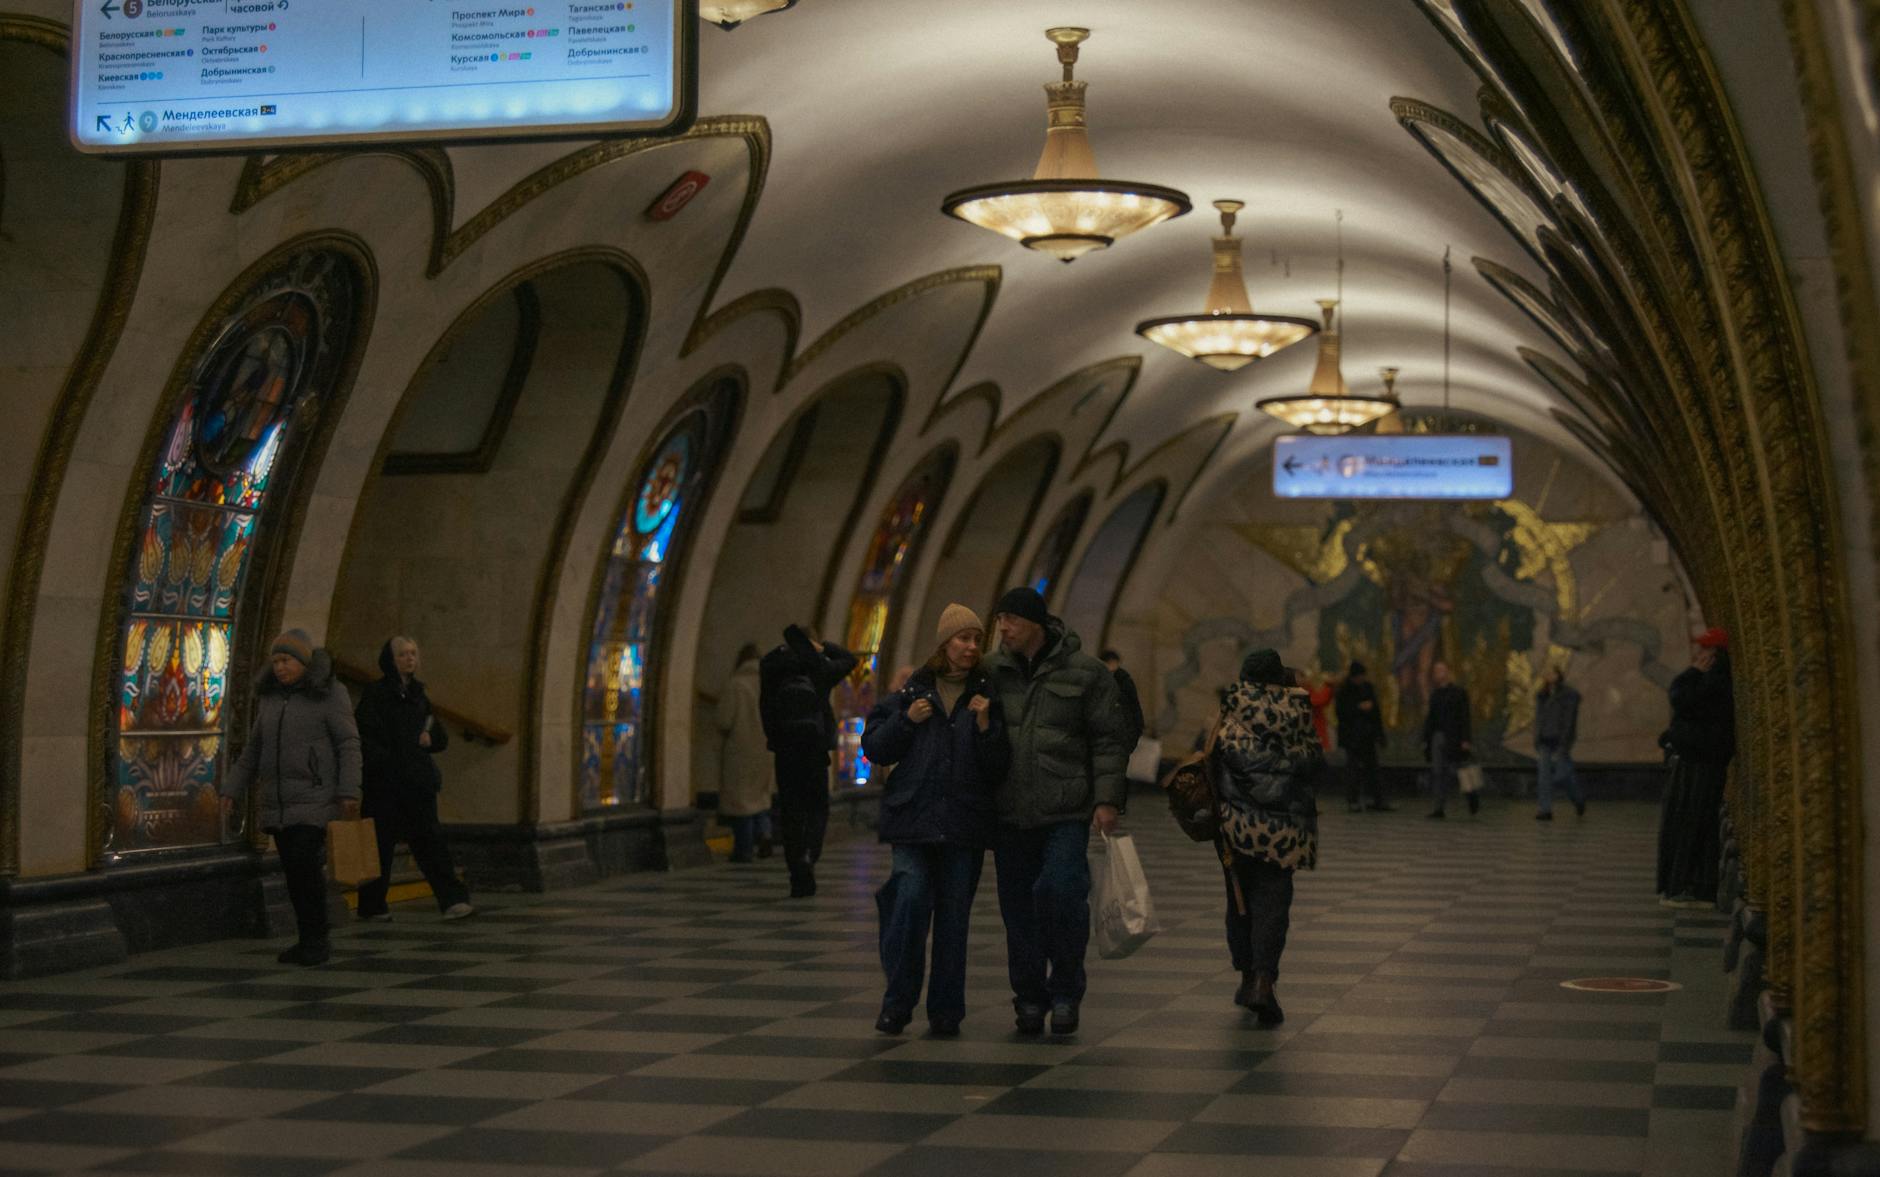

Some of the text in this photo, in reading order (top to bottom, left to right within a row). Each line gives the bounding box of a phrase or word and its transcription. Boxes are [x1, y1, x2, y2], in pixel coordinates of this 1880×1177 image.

[129, 2, 138, 15] 5
[230, 3, 274, 14] часовой
[568, 4, 615, 13] Таганская
[452, 9, 526, 21] Проспект Мира
[202, 23, 267, 36] Парк культуры
[568, 25, 626, 36] Павелецкая
[100, 31, 154, 42] Белорусская
[451, 31, 526, 42] Комсомольская
[99, 50, 185, 62] Краснопресненская
[202, 45, 258, 57] Октябрьская
[568, 47, 640, 59] Добрынинская
[450, 54, 489, 65] Курская
[98, 73, 139, 83] Киевская
[201, 66, 267, 78] Добрынинская
[143, 115, 152, 128] 9
[162, 107, 259, 121] Менделеевская
